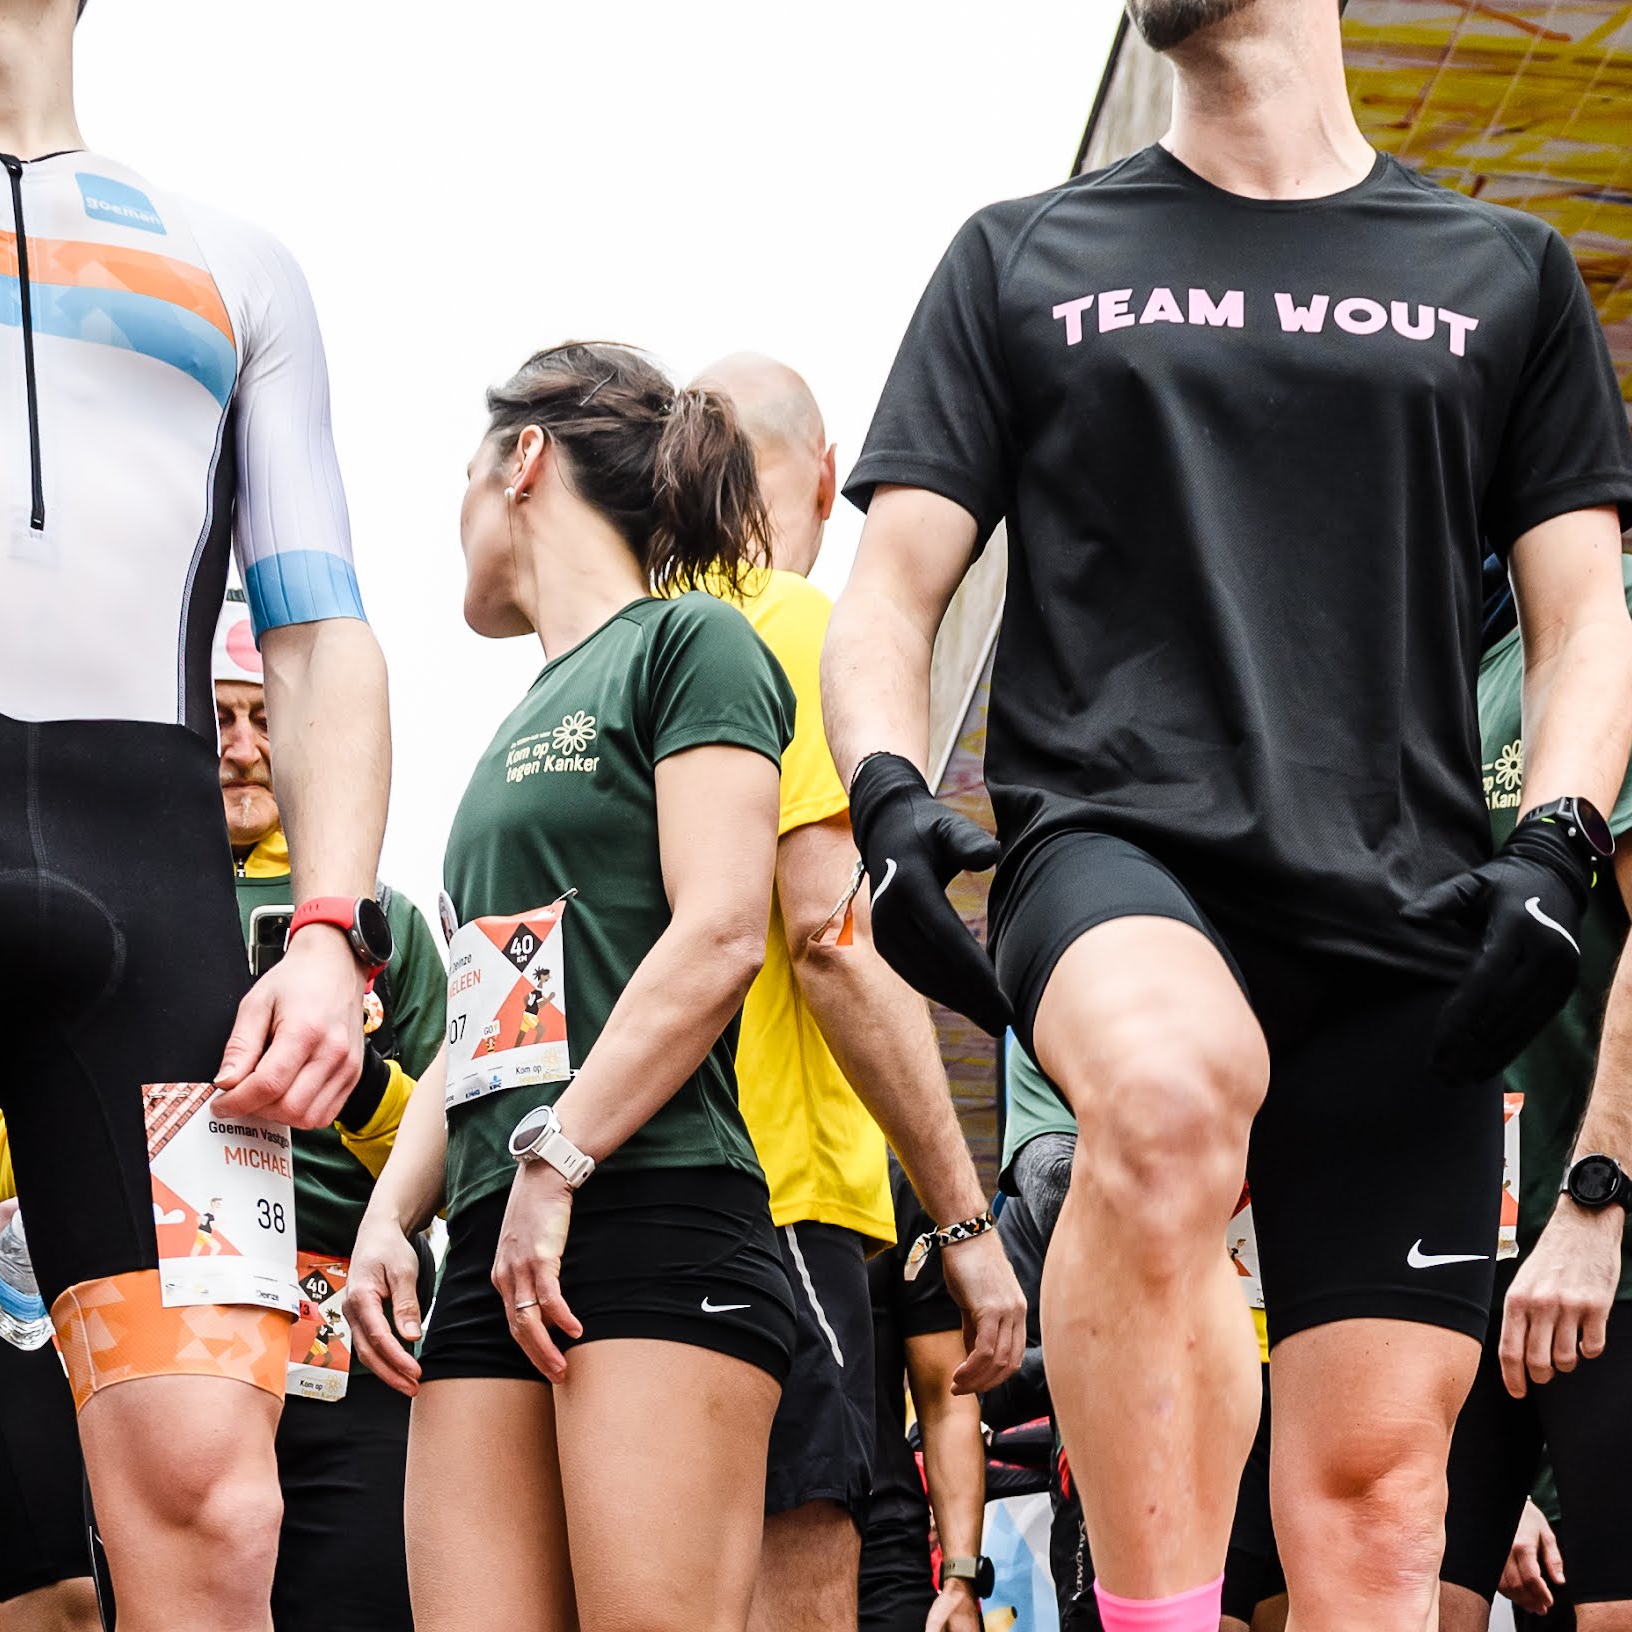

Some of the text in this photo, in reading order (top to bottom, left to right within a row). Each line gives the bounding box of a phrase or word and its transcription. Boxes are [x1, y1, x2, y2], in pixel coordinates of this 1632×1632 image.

[1052, 287, 1479, 357] TEAM WOUT
[506, 742, 550, 767] Kom op
[506, 754, 600, 783] tegen Kanker
[510, 934, 534, 956] 40
[208, 1121, 259, 1139] Goeman
[257, 1198, 286, 1234] 38
[306, 1277, 328, 1296] 40
